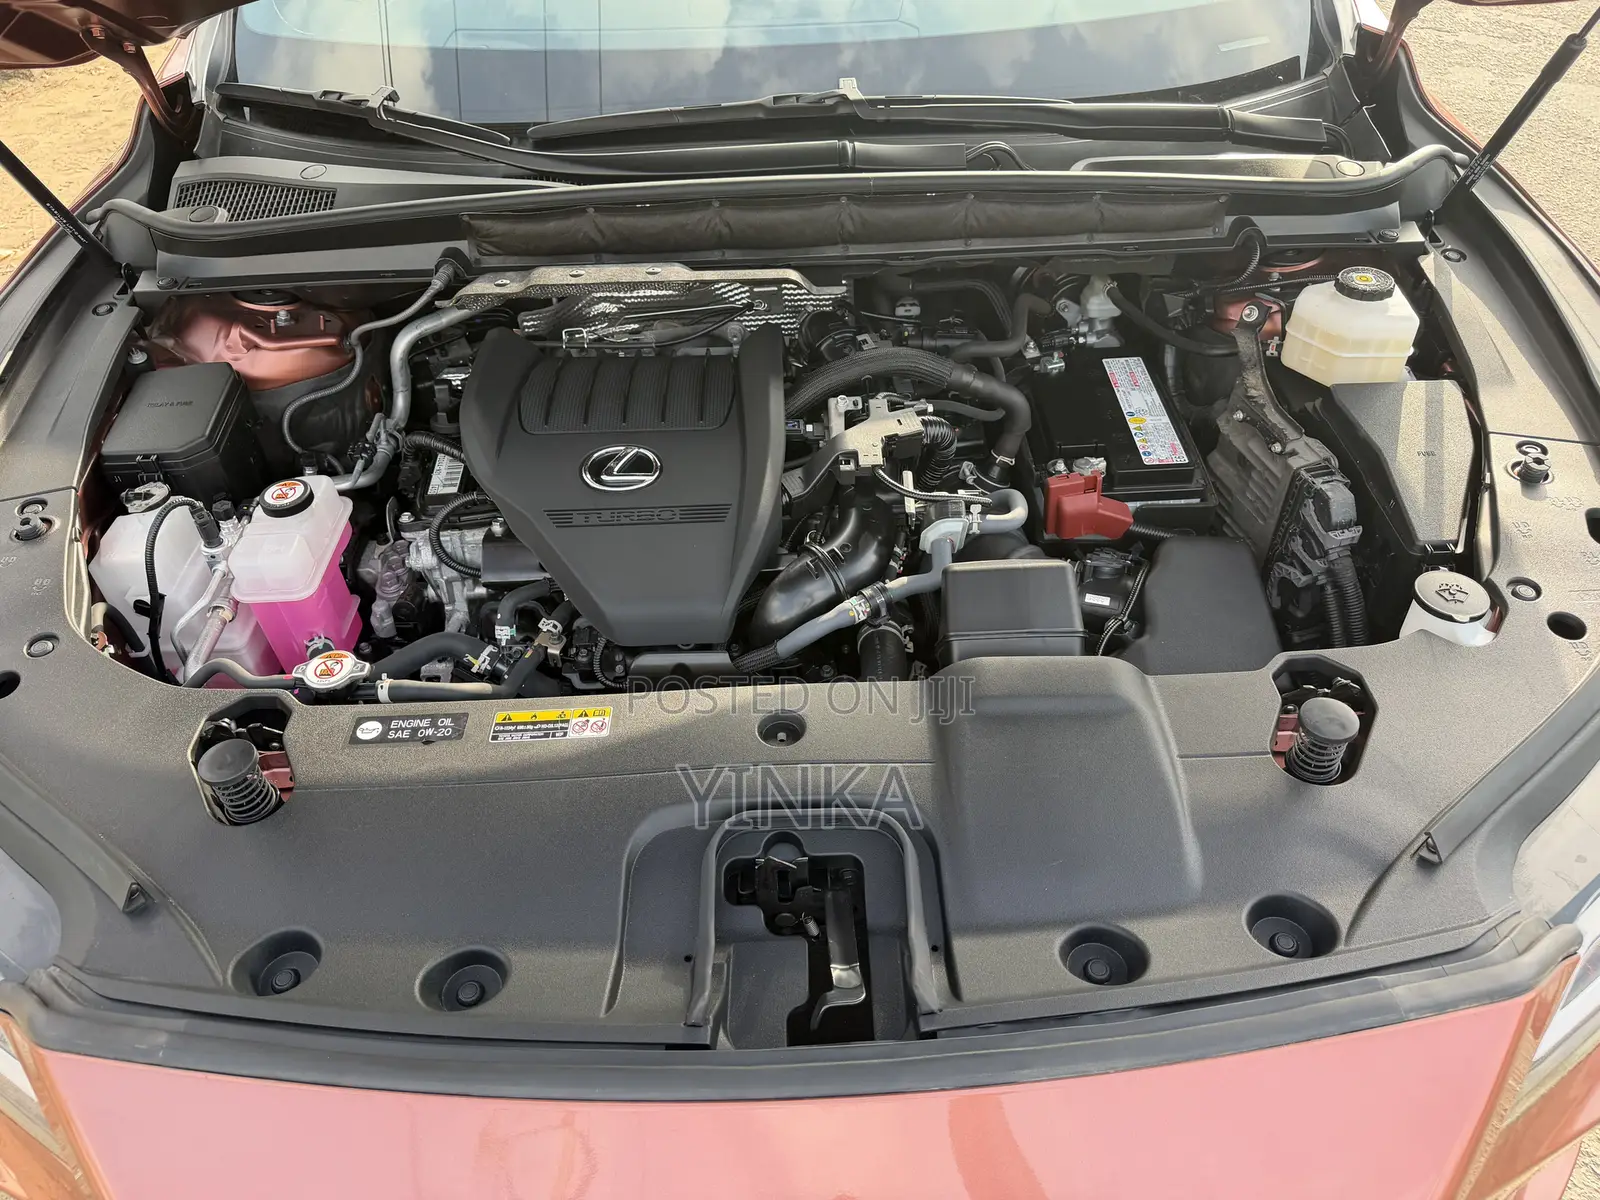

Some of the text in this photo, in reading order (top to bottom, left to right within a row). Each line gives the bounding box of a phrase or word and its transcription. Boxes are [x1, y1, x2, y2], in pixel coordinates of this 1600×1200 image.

[576, 509, 677, 523] TURBO
[390, 717, 455, 729] ENGINE OIL
[387, 729, 411, 739] SAE
